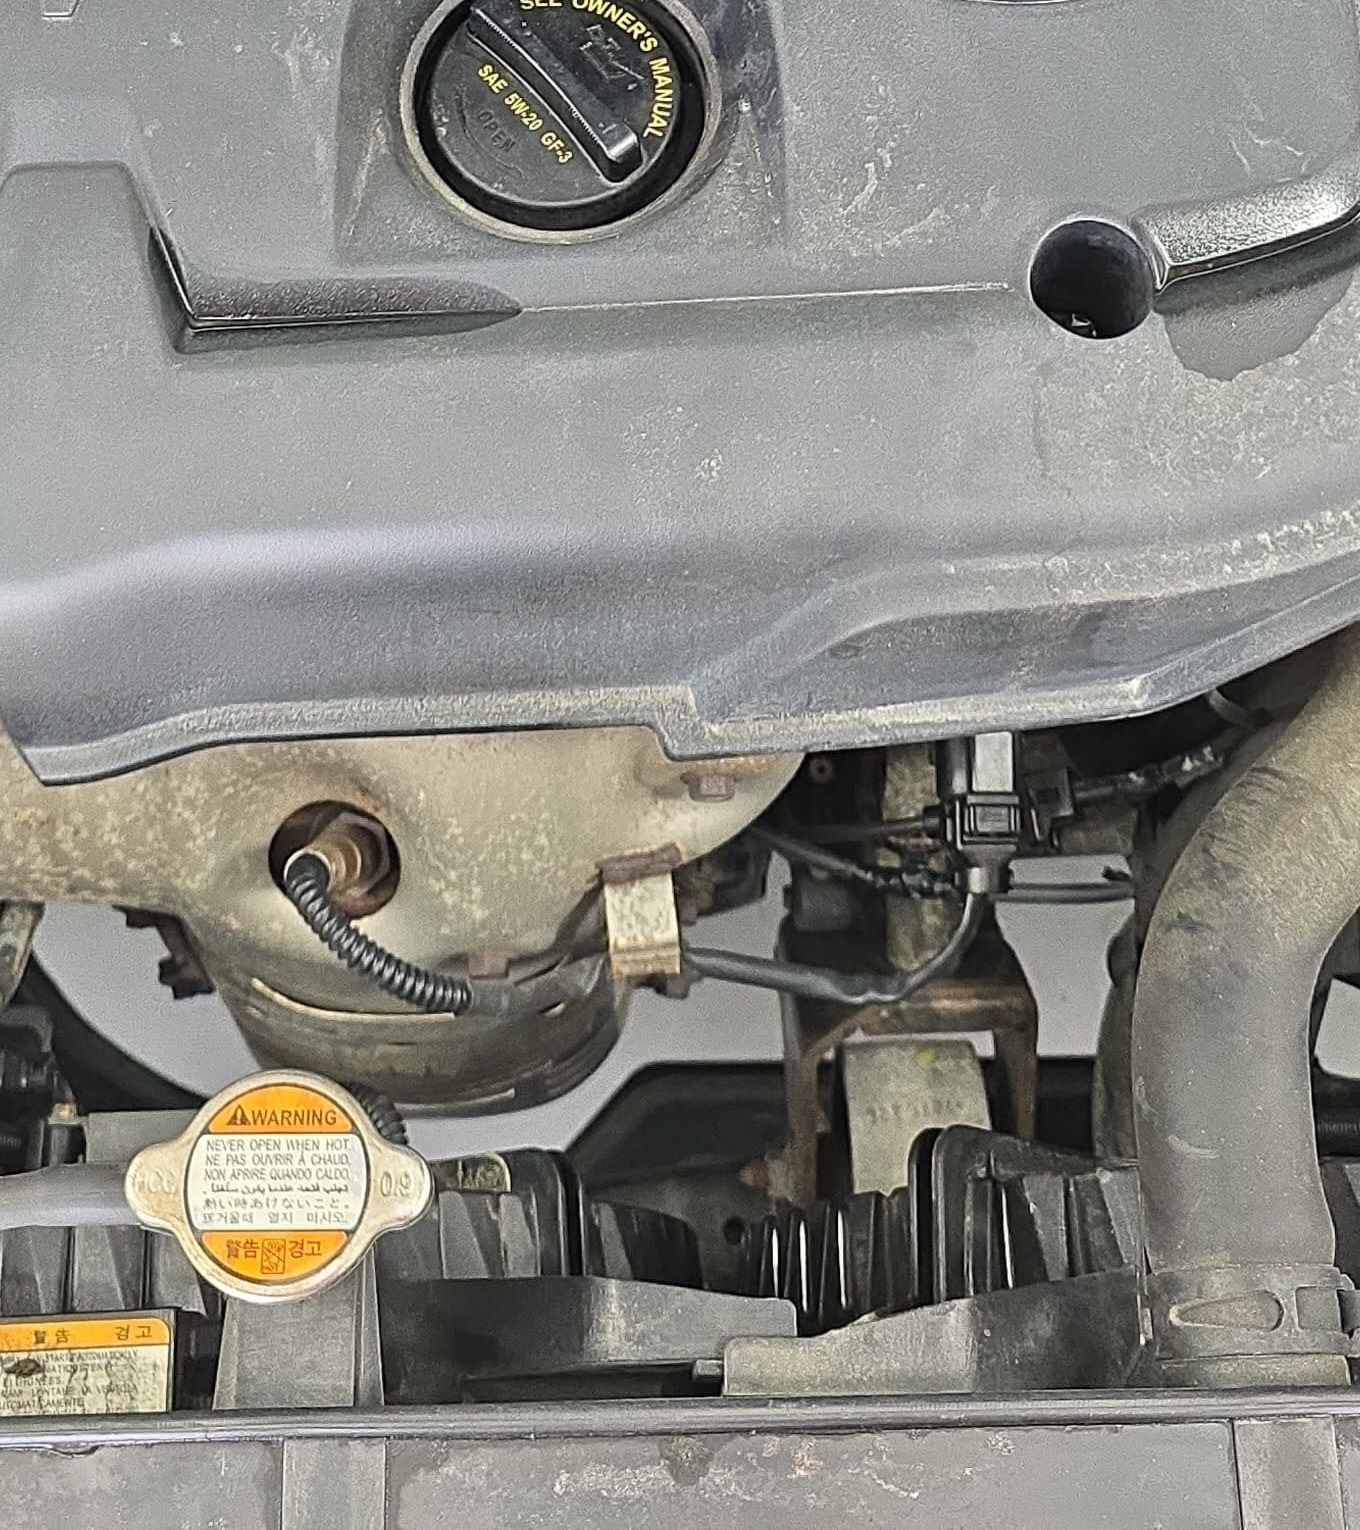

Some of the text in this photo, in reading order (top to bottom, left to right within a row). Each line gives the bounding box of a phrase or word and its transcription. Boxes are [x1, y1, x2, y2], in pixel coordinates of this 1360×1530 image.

[643, 58, 673, 139] MANUAL
[478, 63, 574, 165] SAE 5W-20 GF-3
[478, 109, 516, 152] OPEN
[252, 1109, 336, 1125] WARNING
[206, 1139, 244, 1150] NEVER
[249, 1139, 280, 1150] OPEN
[286, 1139, 319, 1150] WHEN
[205, 1154, 219, 1165] NE
[226, 1154, 245, 1165] PAS
[252, 1153, 292, 1165] OUVRIR
[298, 1152, 305, 1165] À
[205, 1169, 225, 1180] NON
[230, 1168, 264, 1179] APRIRE
[270, 1168, 311, 1179] QUANDO
[288, 1240, 322, 1258] 경고
